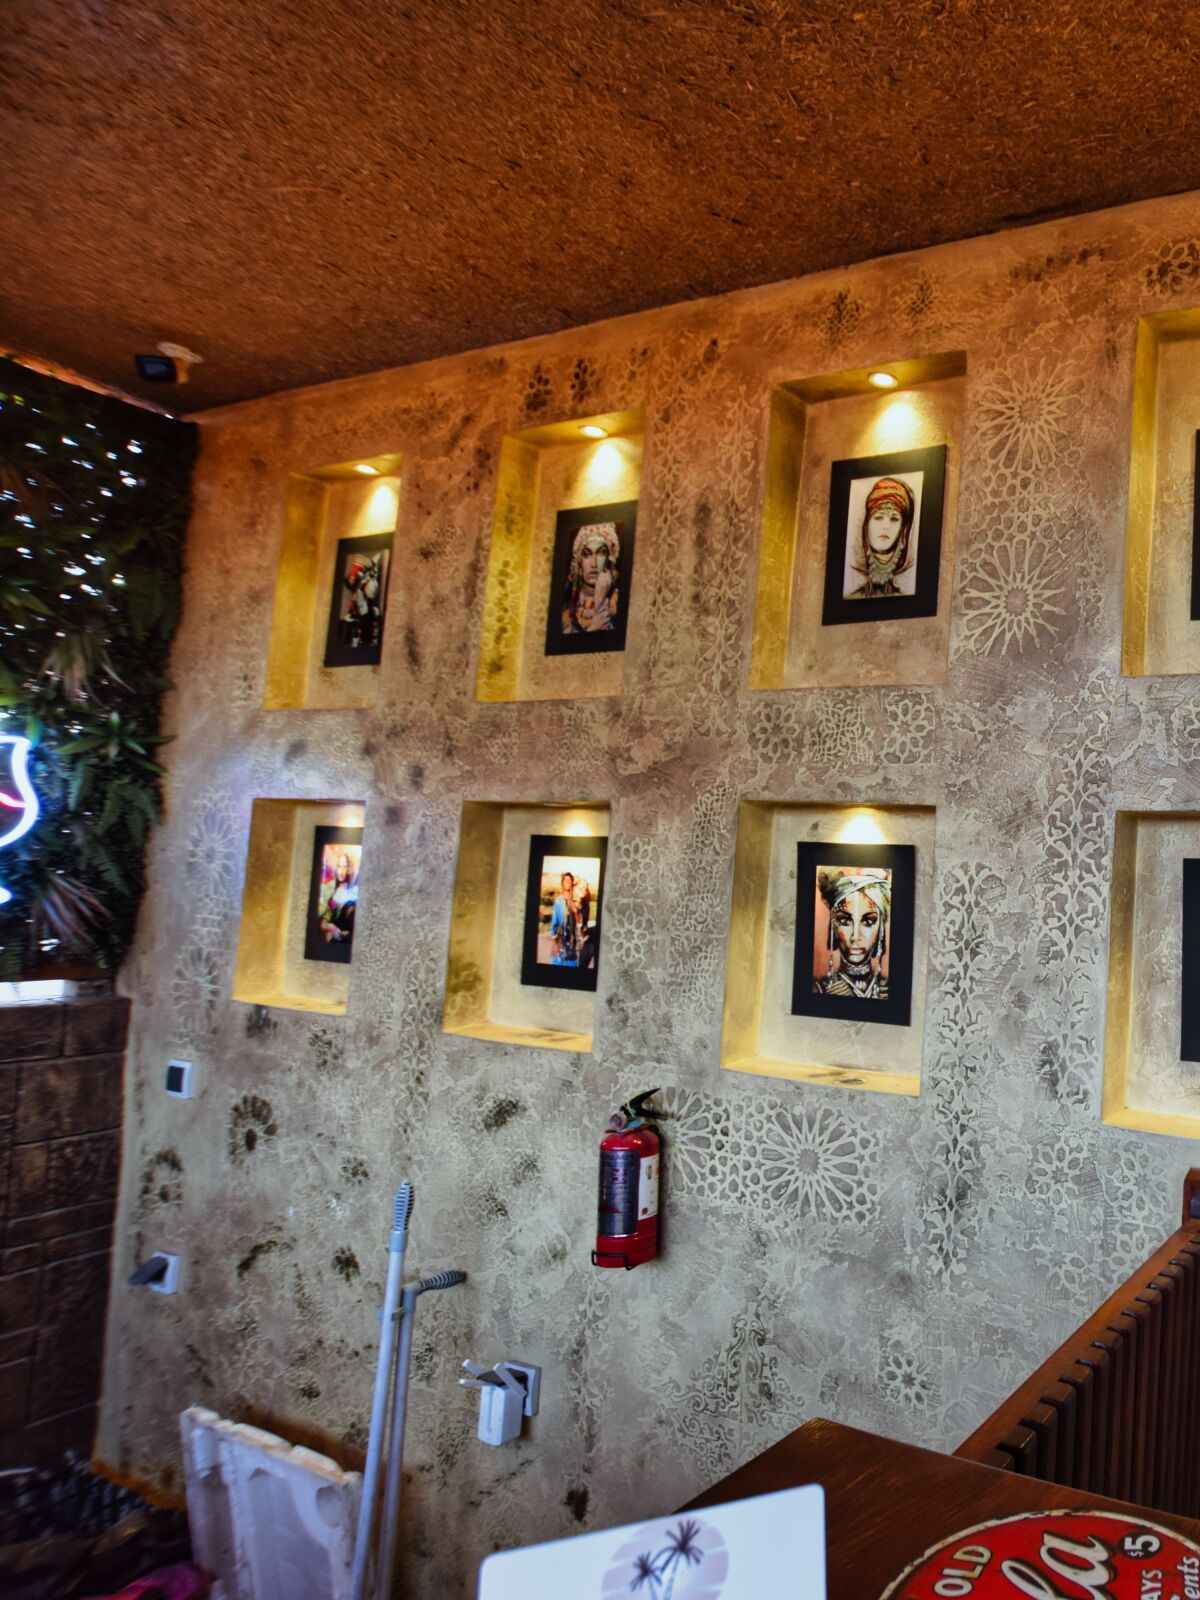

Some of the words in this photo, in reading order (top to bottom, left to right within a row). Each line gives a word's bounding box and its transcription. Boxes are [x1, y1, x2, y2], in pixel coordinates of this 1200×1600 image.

[1124, 1534, 1161, 1557] $5
[933, 1545, 992, 1598] OLD
[1170, 1556, 1200, 1600] ents
